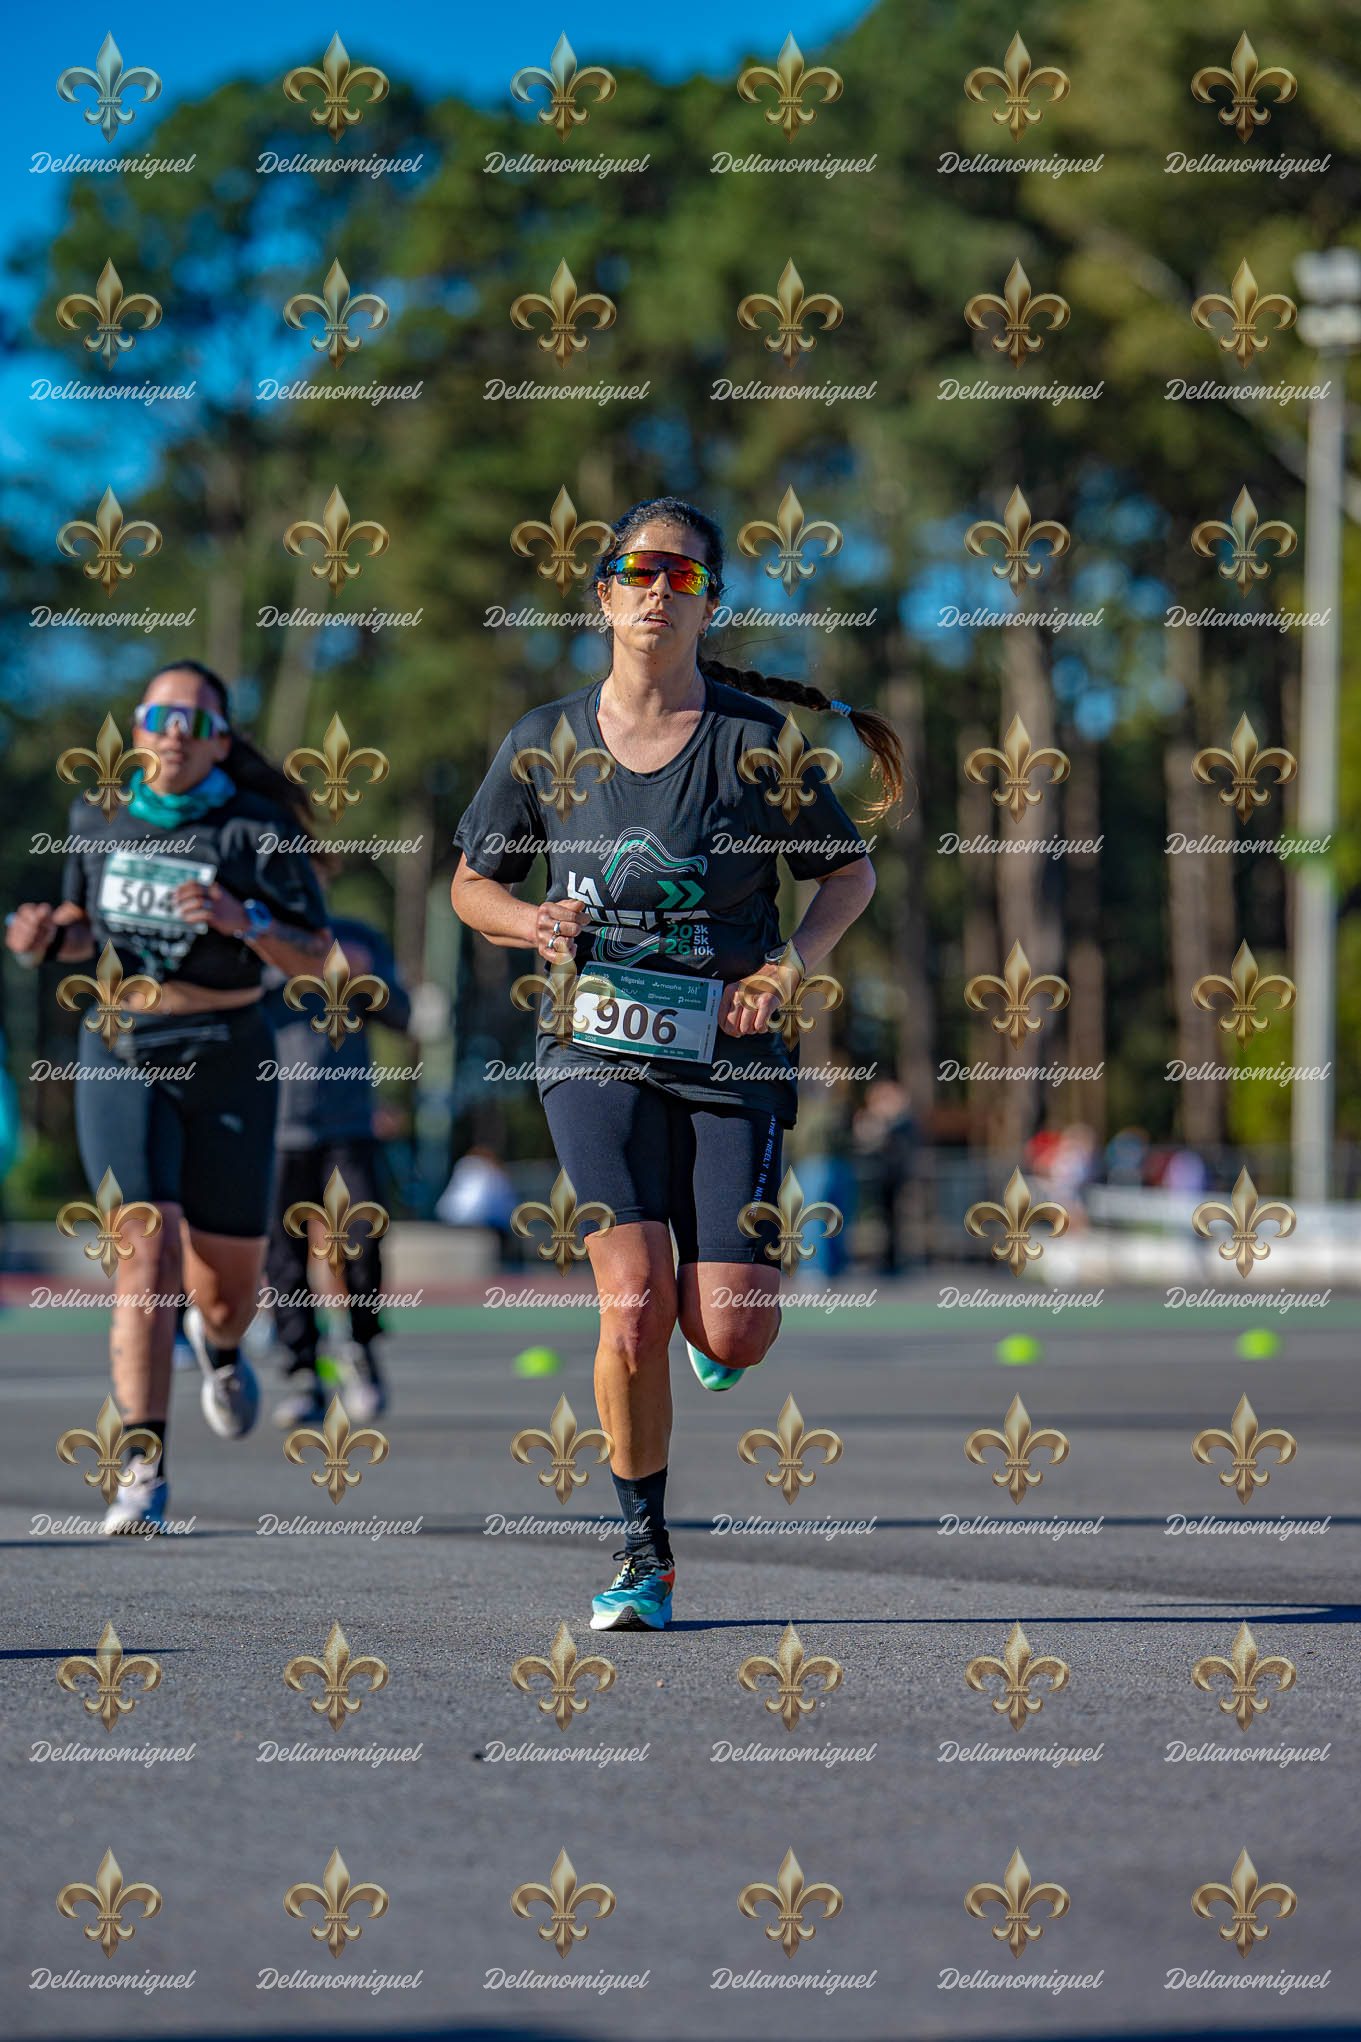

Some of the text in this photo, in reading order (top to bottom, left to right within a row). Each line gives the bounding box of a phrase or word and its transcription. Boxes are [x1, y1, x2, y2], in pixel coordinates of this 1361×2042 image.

[567, 871, 604, 907] LA
[664, 938, 691, 955] 26
[693, 935, 709, 945] 5k
[693, 945, 714, 956] 10k
[594, 996, 679, 1045] 906
